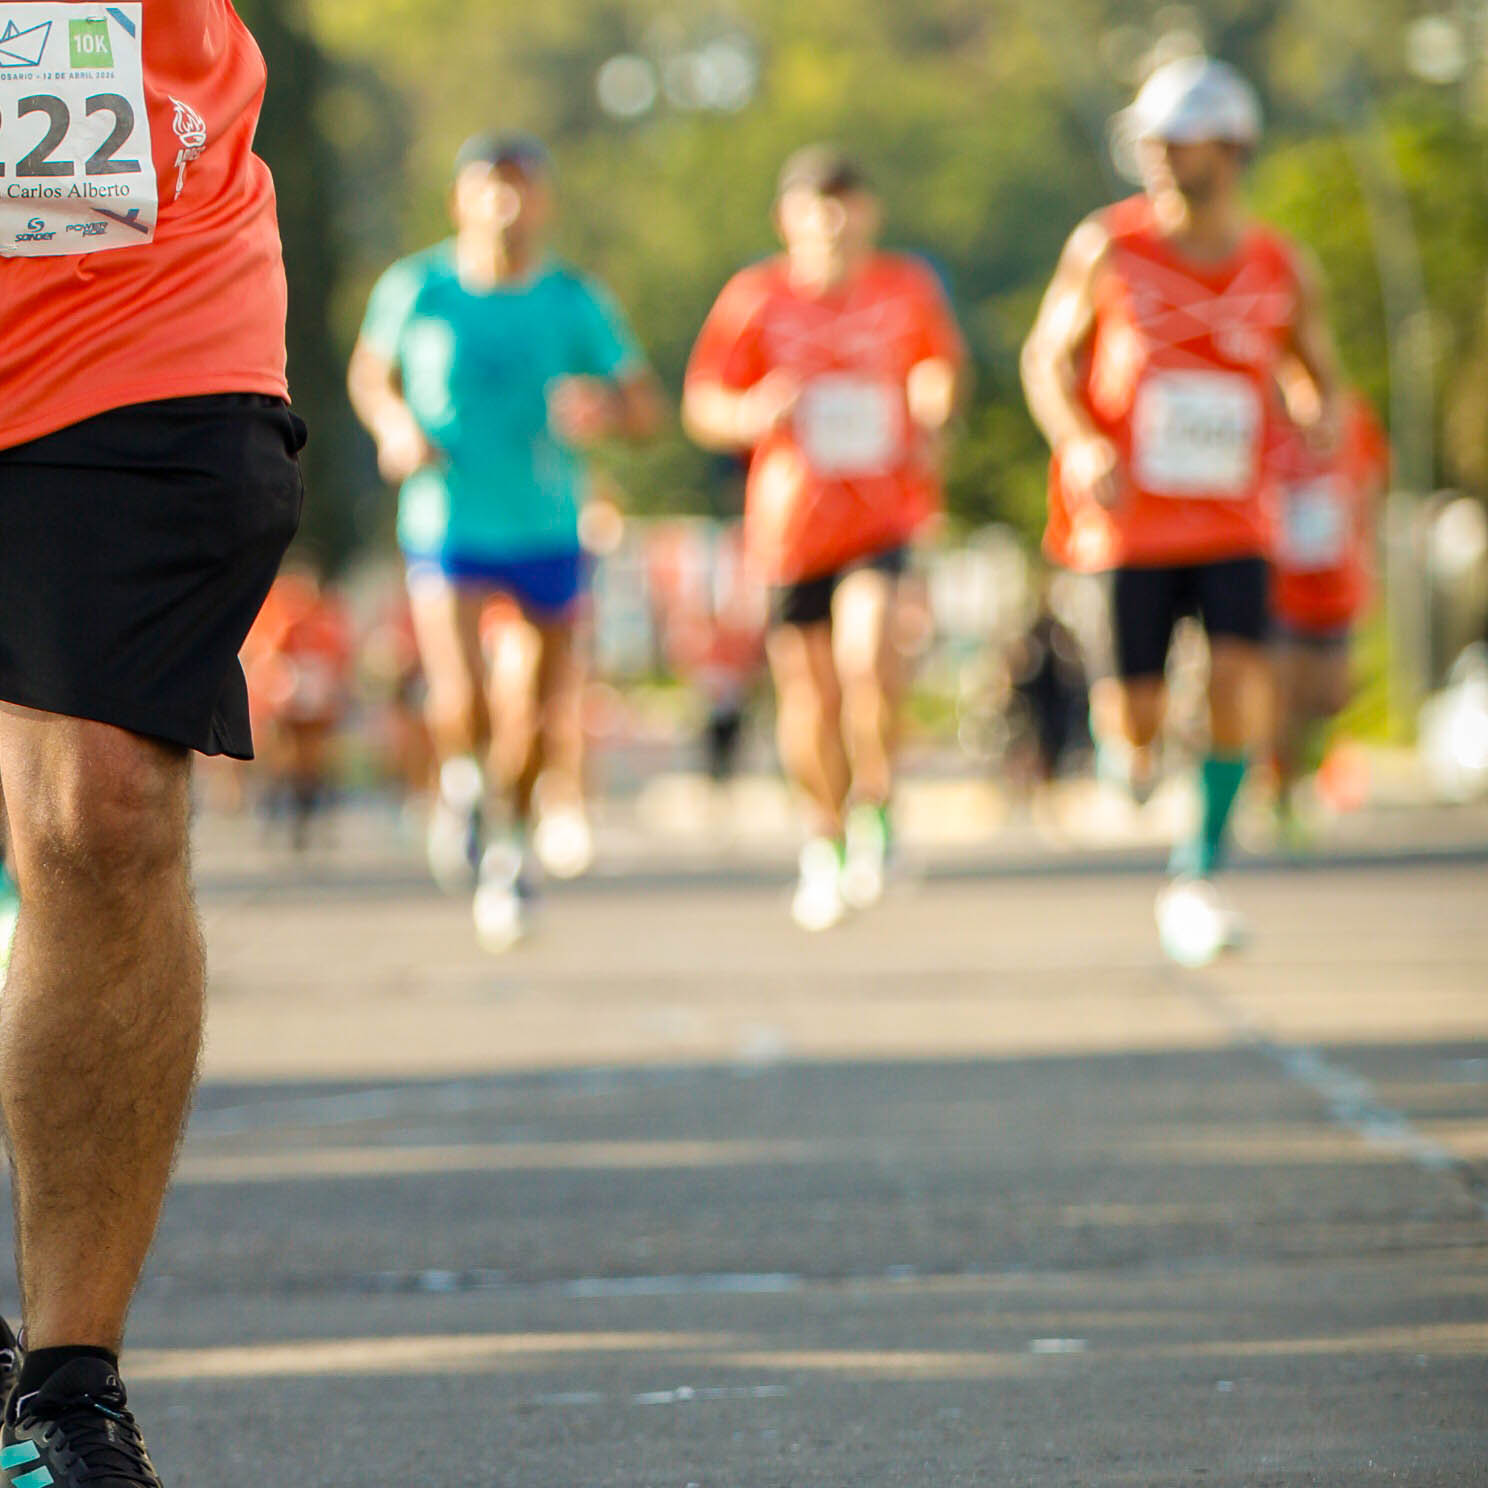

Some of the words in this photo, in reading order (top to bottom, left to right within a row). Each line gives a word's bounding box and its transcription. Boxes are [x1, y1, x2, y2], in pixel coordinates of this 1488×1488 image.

[74, 33, 109, 54] 10K
[55, 72, 65, 80] DE
[69, 71, 93, 80] ABRIL
[7, 183, 62, 200] Carlos
[67, 182, 130, 199] Alberto
